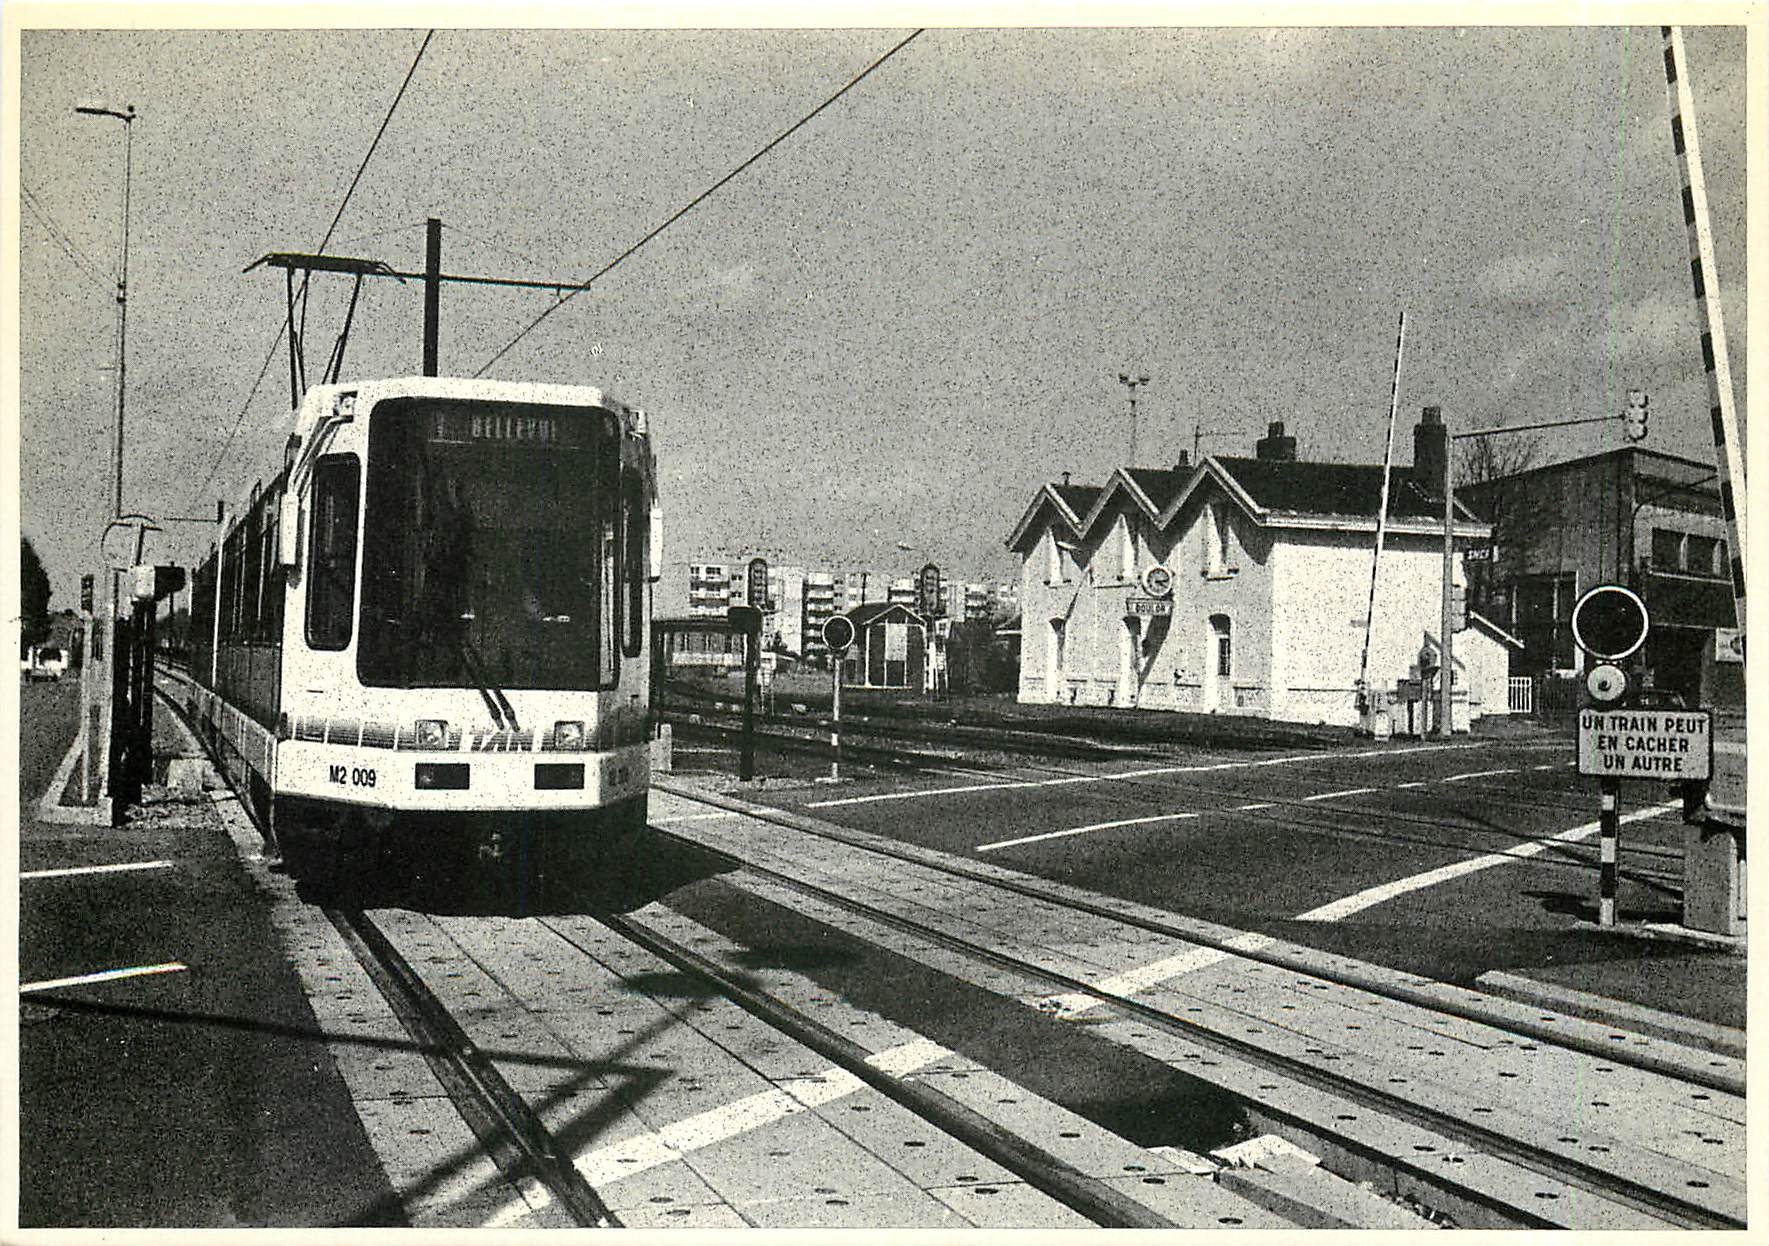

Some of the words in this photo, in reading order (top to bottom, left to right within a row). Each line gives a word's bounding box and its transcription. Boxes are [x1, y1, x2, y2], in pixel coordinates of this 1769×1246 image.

[1582, 715, 1604, 730] UN
[1610, 716, 1657, 731] TRAIN
[1665, 718, 1707, 733] PEUT
[1598, 735, 1618, 750] EN
[1626, 737, 1689, 752] CACHER
[1604, 754, 1625, 769] UN
[1632, 756, 1683, 772] AUTRE
[329, 765, 347, 784] M2
[352, 767, 376, 788] 009
